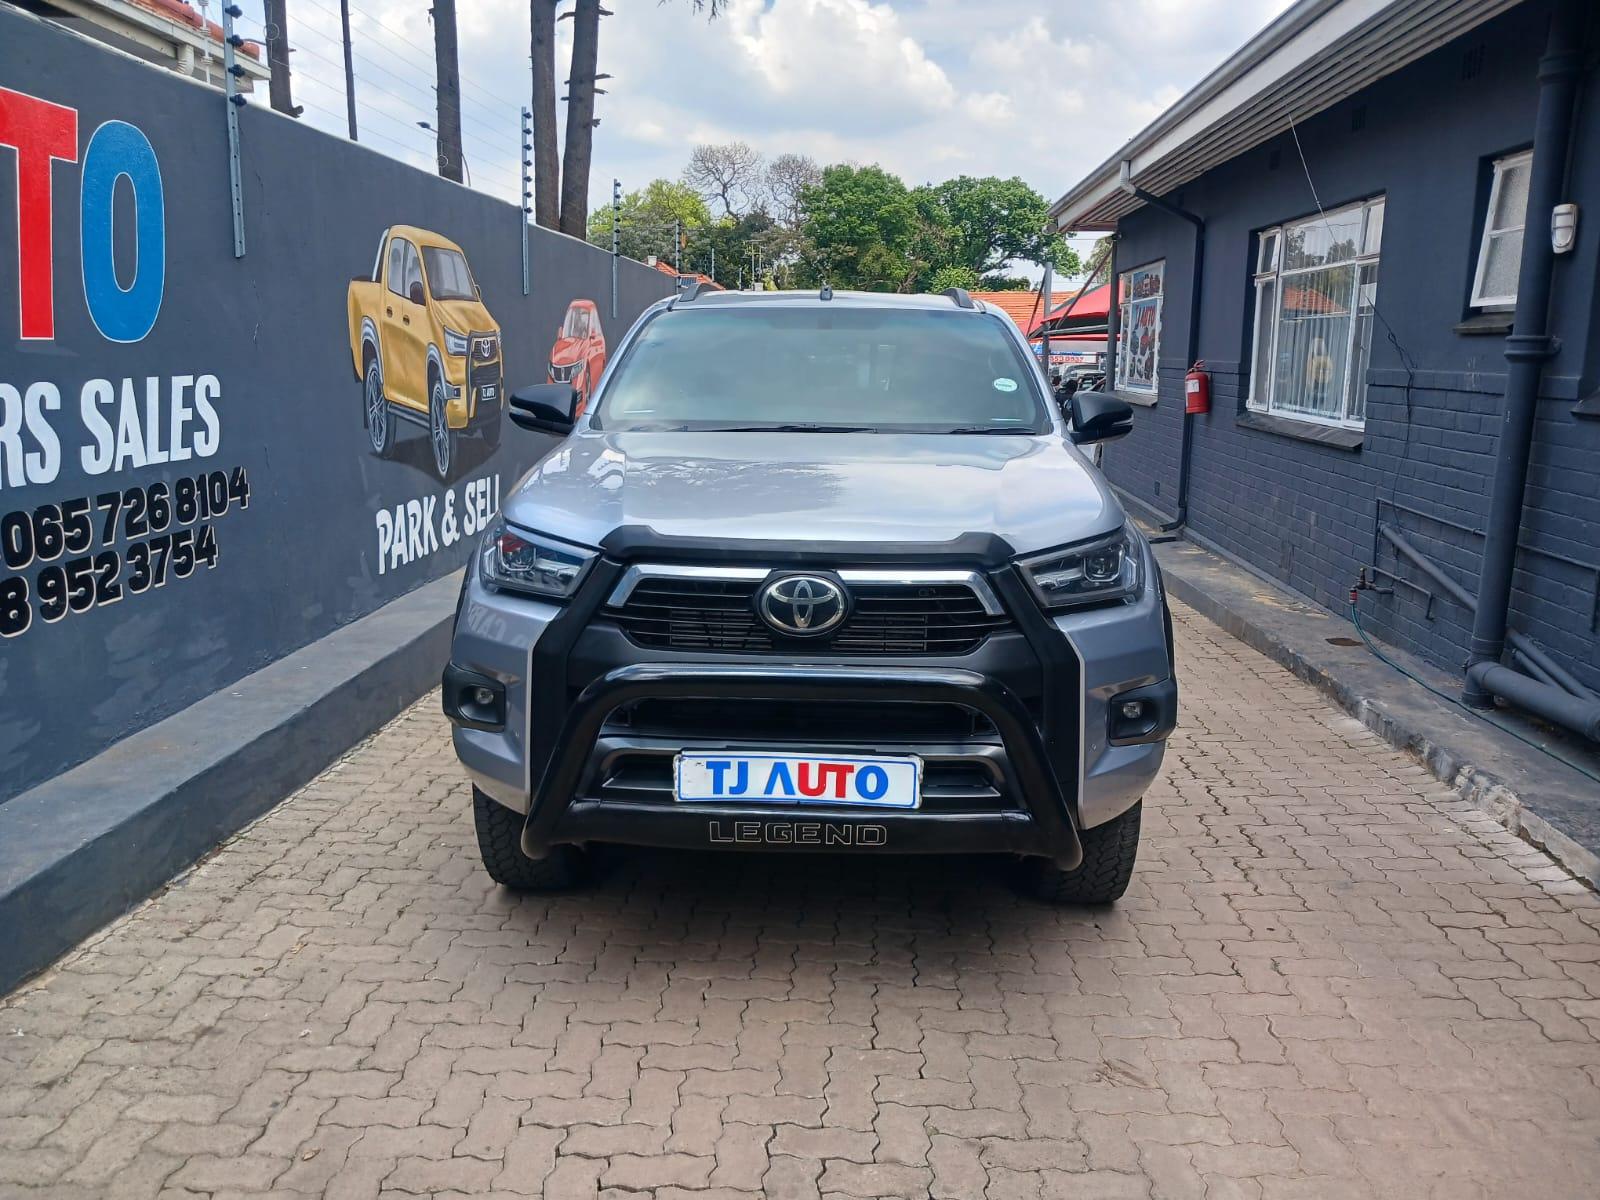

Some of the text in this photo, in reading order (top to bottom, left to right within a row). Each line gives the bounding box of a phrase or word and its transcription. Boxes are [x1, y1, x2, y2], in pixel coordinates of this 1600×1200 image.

[80, 374, 221, 475] SALES
[0, 466, 251, 570] 065 726 8104
[376, 495, 439, 574] PARK
[441, 489, 461, 547] &
[0, 525, 219, 638] 8 952 3754
[705, 760, 889, 800] TJ AUTO
[709, 821, 888, 846] LEGEND
